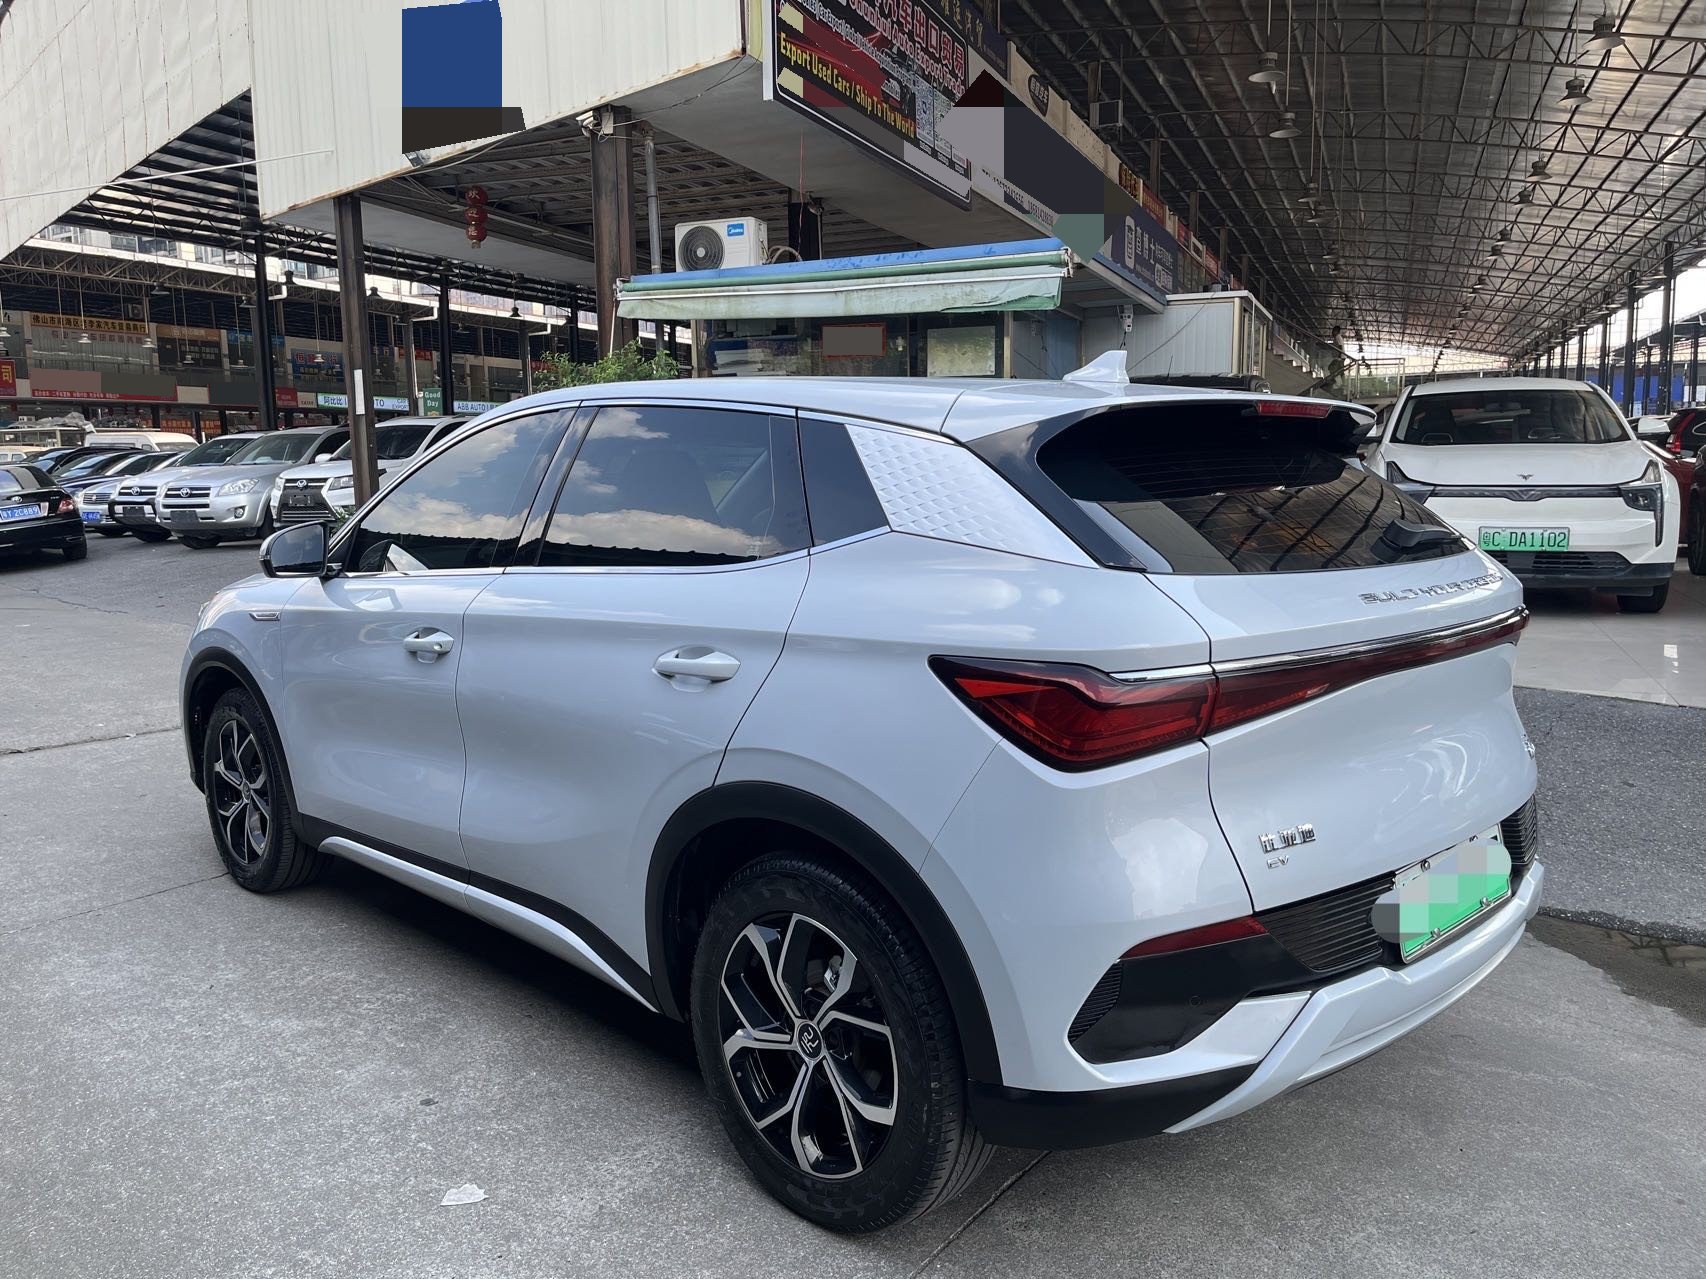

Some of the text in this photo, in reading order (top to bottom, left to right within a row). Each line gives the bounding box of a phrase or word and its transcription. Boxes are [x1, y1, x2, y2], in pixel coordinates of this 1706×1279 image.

[892, 24, 914, 59] Auto
[915, 42, 943, 83] Export
[780, 32, 810, 71] Export
[812, 55, 831, 84] Used
[834, 68, 850, 97] Cars
[856, 85, 872, 114] Ship
[873, 96, 882, 118] To
[882, 103, 895, 126] The
[895, 112, 915, 139] World
[426, 400, 439, 408] Day
[470, 403, 486, 411] AUTO
[1509, 531, 1567, 548] DA1102
[1266, 855, 1289, 869] EV
